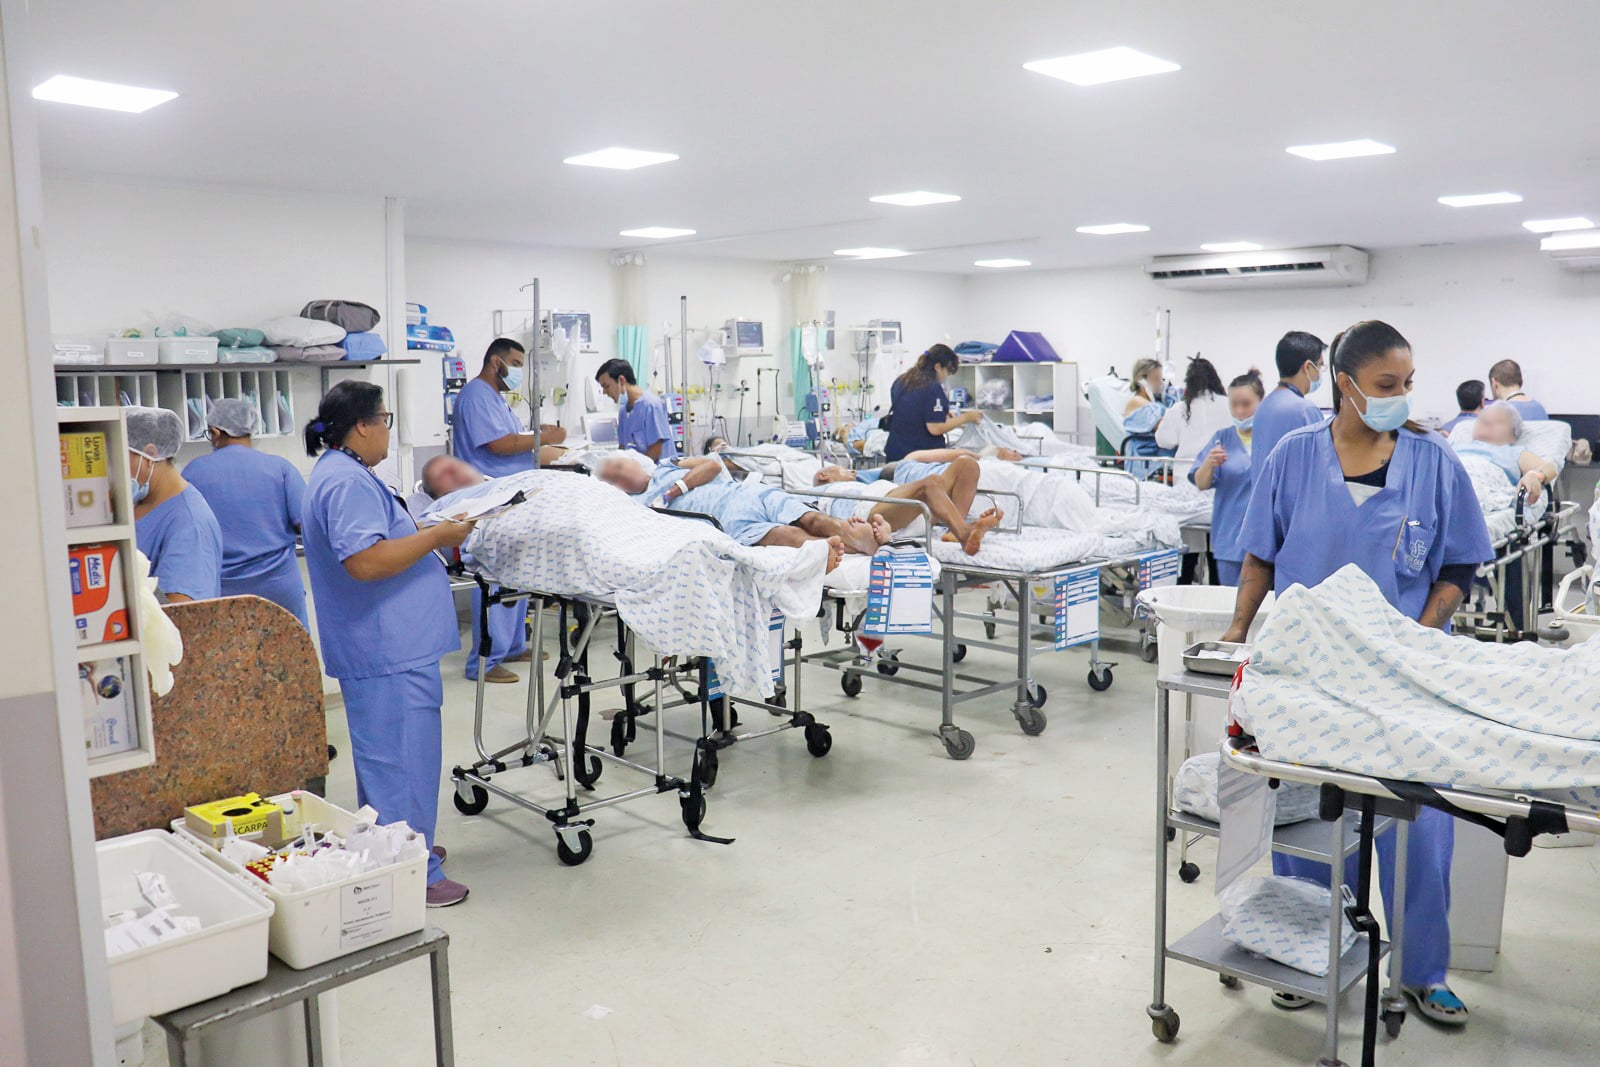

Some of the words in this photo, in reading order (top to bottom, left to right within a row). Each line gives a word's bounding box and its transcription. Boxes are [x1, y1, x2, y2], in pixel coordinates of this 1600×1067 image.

[84, 437, 92, 449] de
[93, 436, 101, 462] Luvas
[89, 556, 102, 587] Medix
